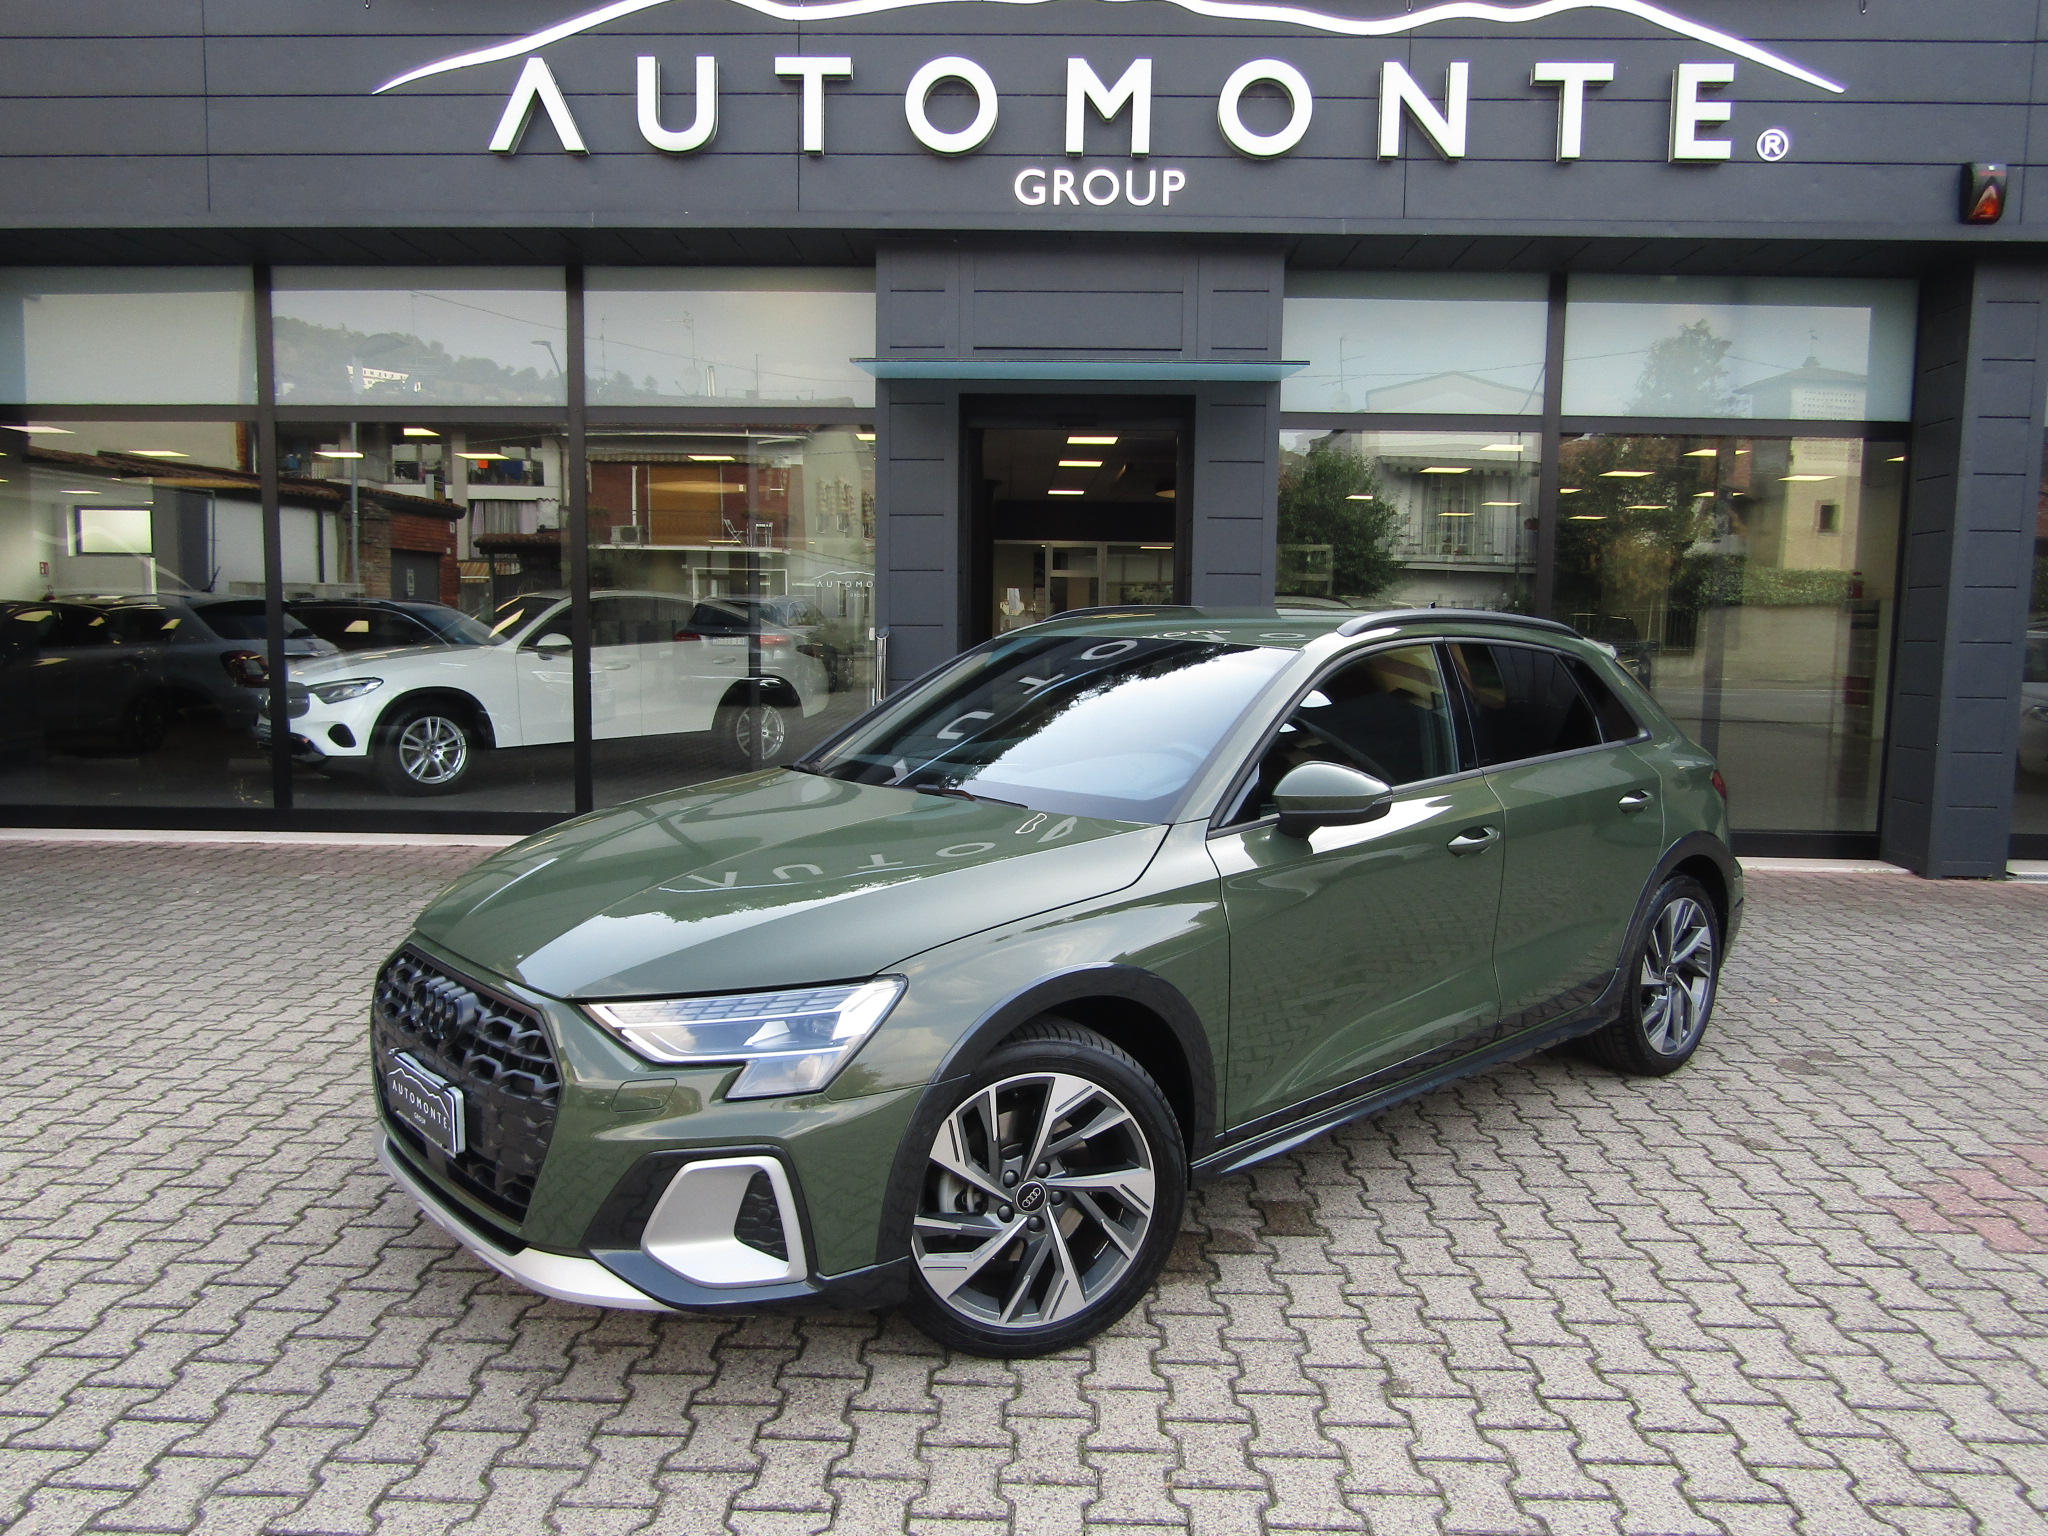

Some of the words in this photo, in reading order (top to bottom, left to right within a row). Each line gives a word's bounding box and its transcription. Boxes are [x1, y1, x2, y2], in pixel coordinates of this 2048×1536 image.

[488, 56, 1735, 163] AUTOMONTE
[1013, 168, 1187, 207] GROUP
[816, 580, 874, 588] AUTOMO
[392, 1079, 448, 1129] AUTOMONTE
